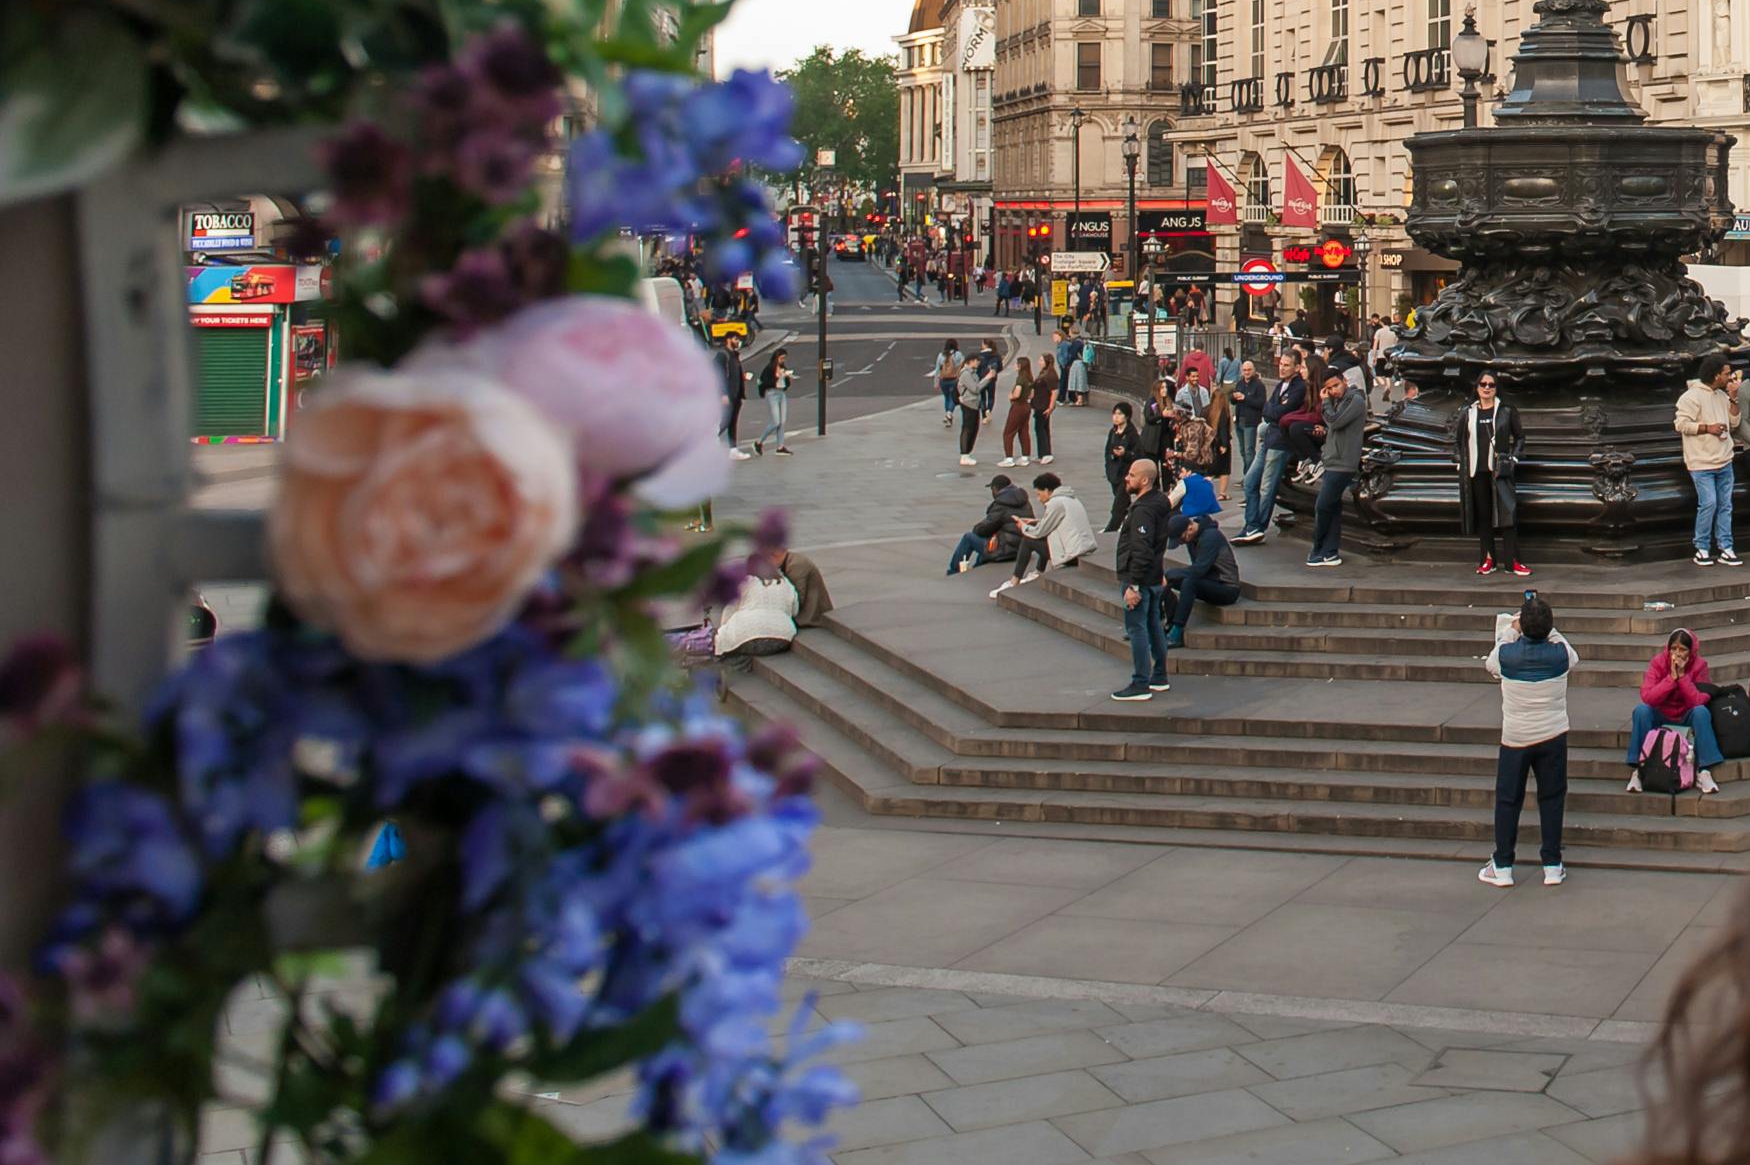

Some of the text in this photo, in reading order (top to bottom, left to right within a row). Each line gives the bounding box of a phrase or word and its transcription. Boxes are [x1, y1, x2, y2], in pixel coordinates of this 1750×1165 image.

[194, 214, 252, 230] TOBACCO
[1161, 217, 1202, 228] ANGUS
[1384, 254, 1402, 266] SHOP
[1233, 274, 1284, 282] UNDERGROUND
